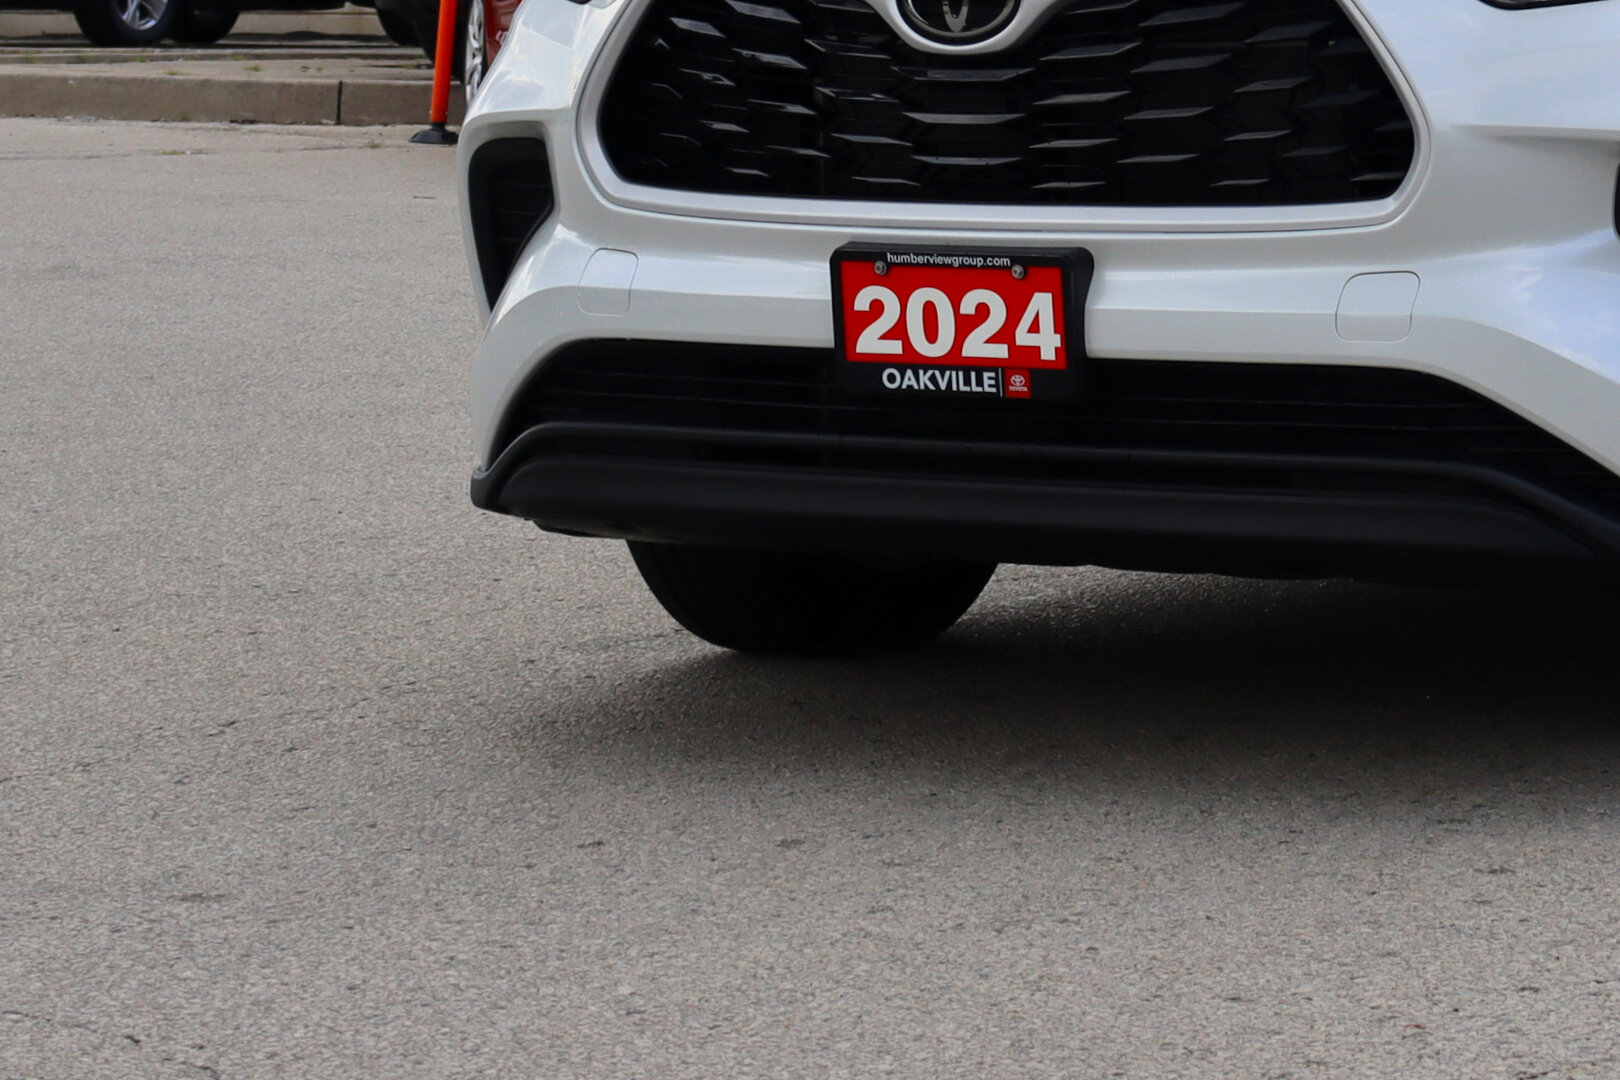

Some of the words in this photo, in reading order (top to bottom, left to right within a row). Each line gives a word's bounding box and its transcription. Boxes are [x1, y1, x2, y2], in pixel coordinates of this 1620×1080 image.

[886, 252, 1011, 268] humberviewgroup.com
[853, 284, 1062, 361] 2024
[881, 367, 997, 393] OAKVILLE
